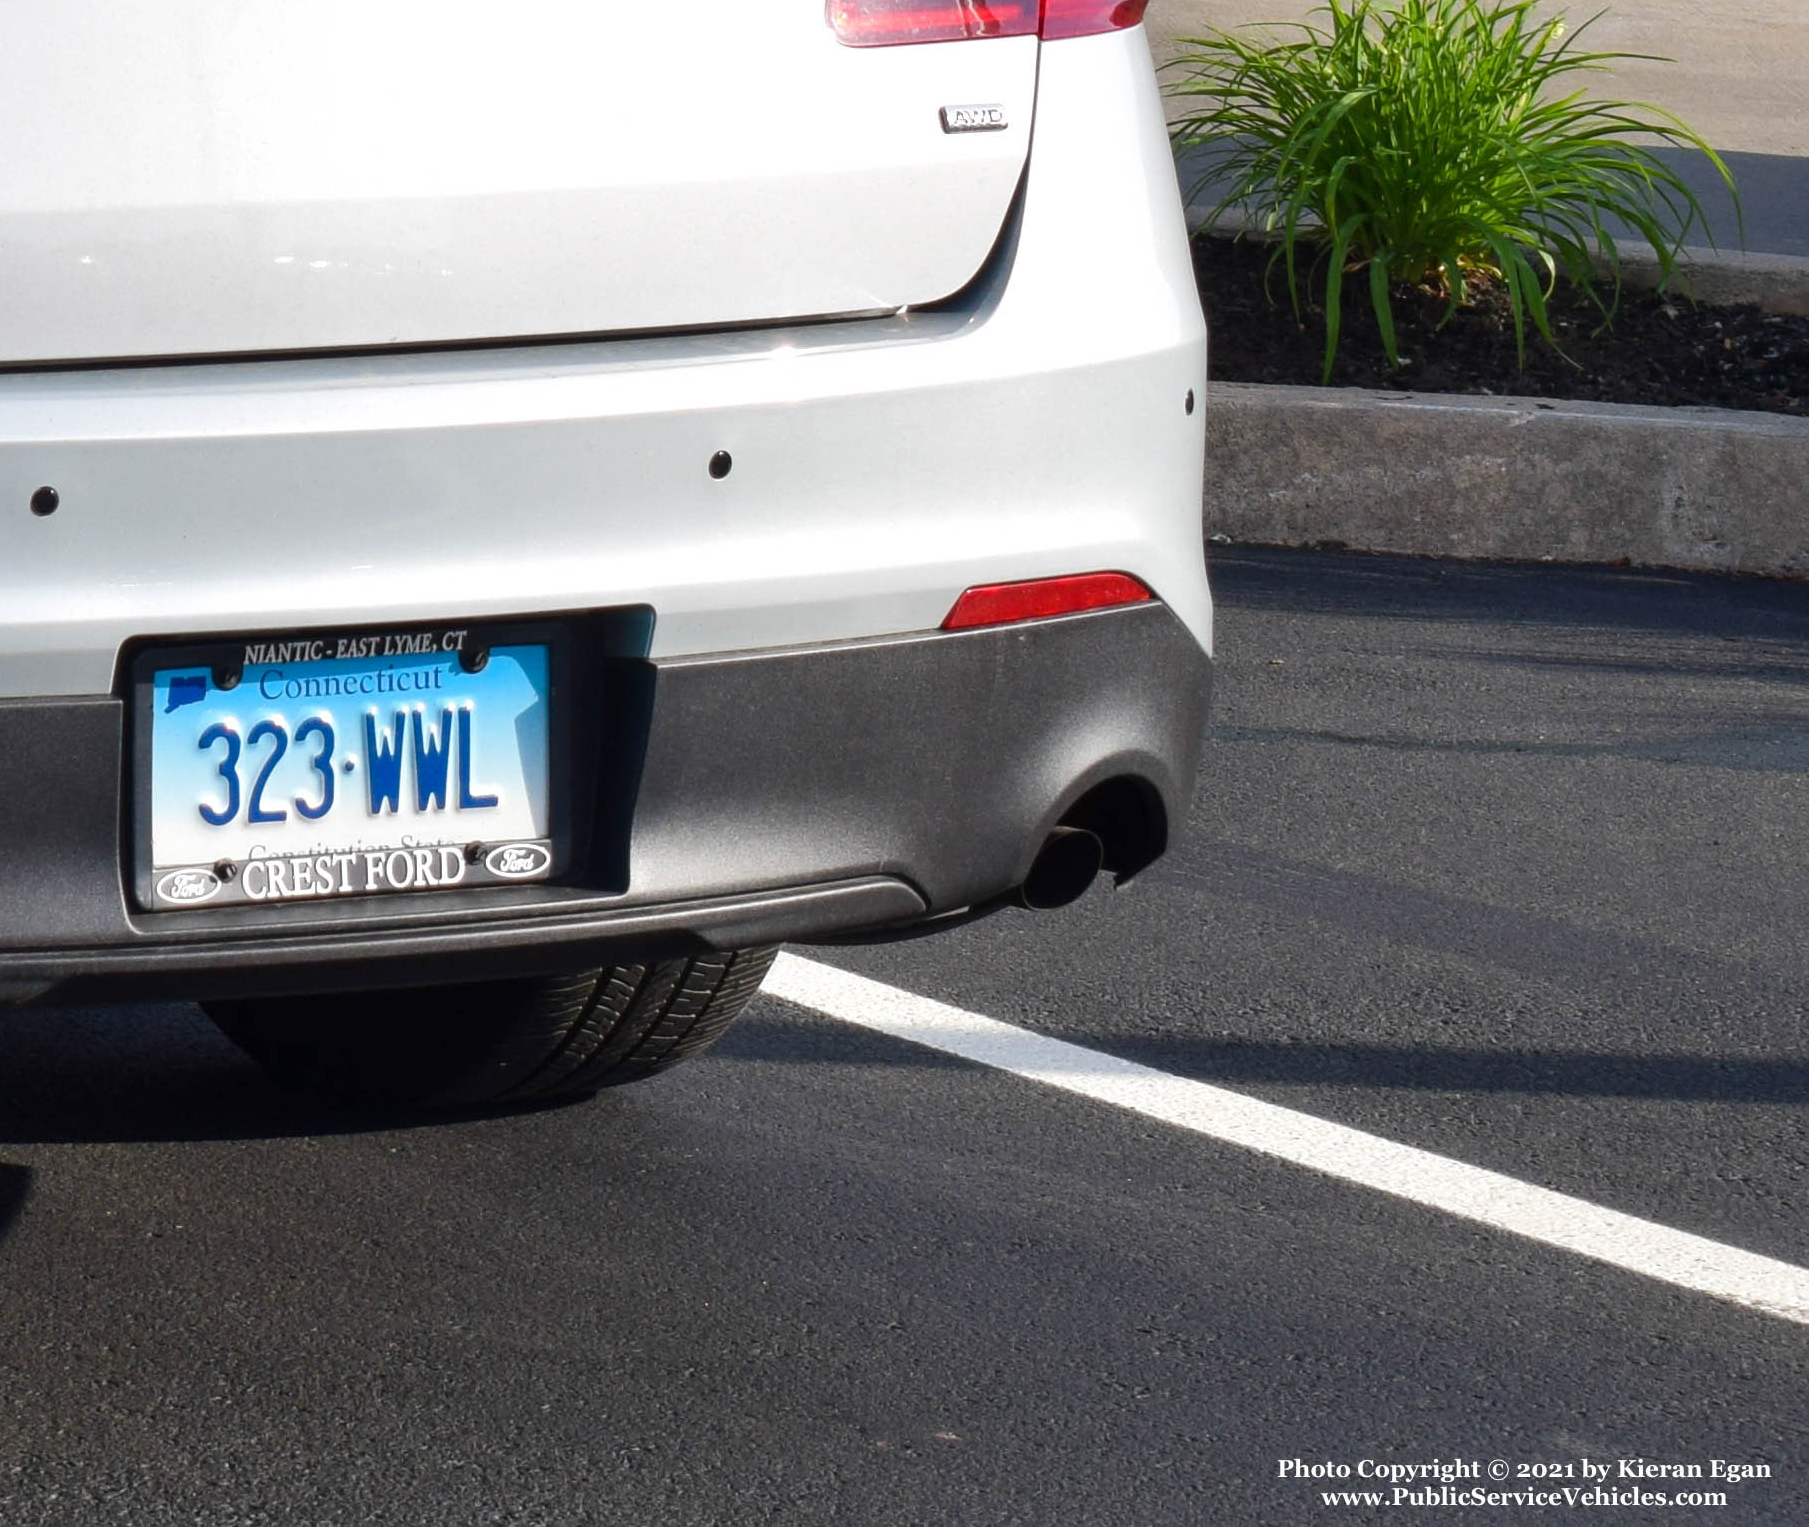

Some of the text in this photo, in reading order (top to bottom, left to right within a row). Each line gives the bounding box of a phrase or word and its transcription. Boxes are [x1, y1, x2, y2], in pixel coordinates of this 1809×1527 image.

[244, 640, 325, 665] NIANTIC
[336, 636, 381, 659] EAST
[383, 632, 437, 656] LYME,
[442, 630, 468, 651] CT
[259, 664, 443, 700] Connecticut
[242, 853, 356, 899] CREST
[364, 847, 466, 890] FORD
